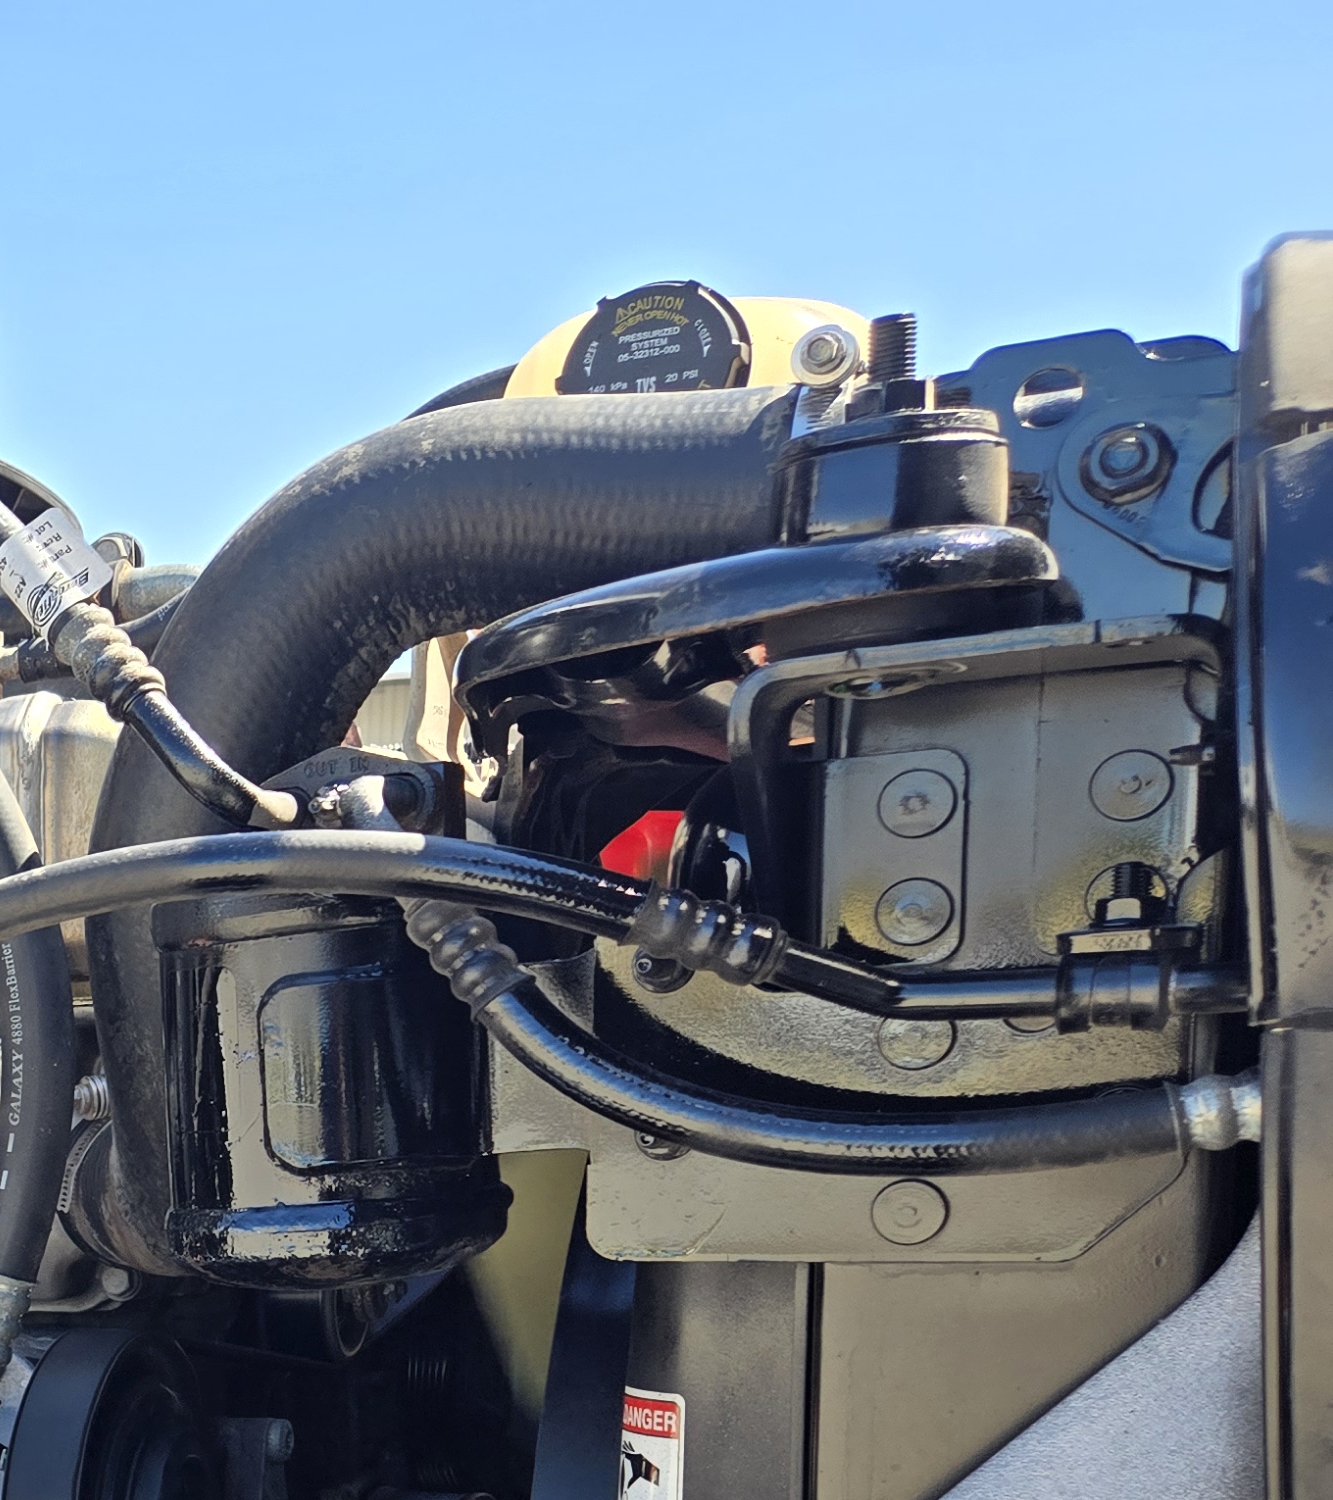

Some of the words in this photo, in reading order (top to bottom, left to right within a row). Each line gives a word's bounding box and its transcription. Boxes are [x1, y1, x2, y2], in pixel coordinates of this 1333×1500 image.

[627, 295, 685, 314] CAUTION
[611, 313, 644, 337] NEVER
[644, 310, 670, 320] OPEN
[670, 312, 690, 327] HOT
[617, 326, 680, 344] PRESSURIZED
[631, 338, 668, 351] SYSTEM
[583, 341, 600, 365] OPEN
[610, 382, 628, 391] kPa
[635, 376, 657, 393] TVS
[665, 372, 678, 383] 20
[682, 369, 699, 380] PSI
[34, 521, 53, 536] Lot
[303, 758, 339, 778] OUT
[349, 755, 370, 772] IN
[1, 943, 21, 1012] FlexBarrier
[10, 1015, 23, 1045] 4880
[8, 1049, 24, 1126] GALAXY
[623, 1404, 677, 1432] DANGER
